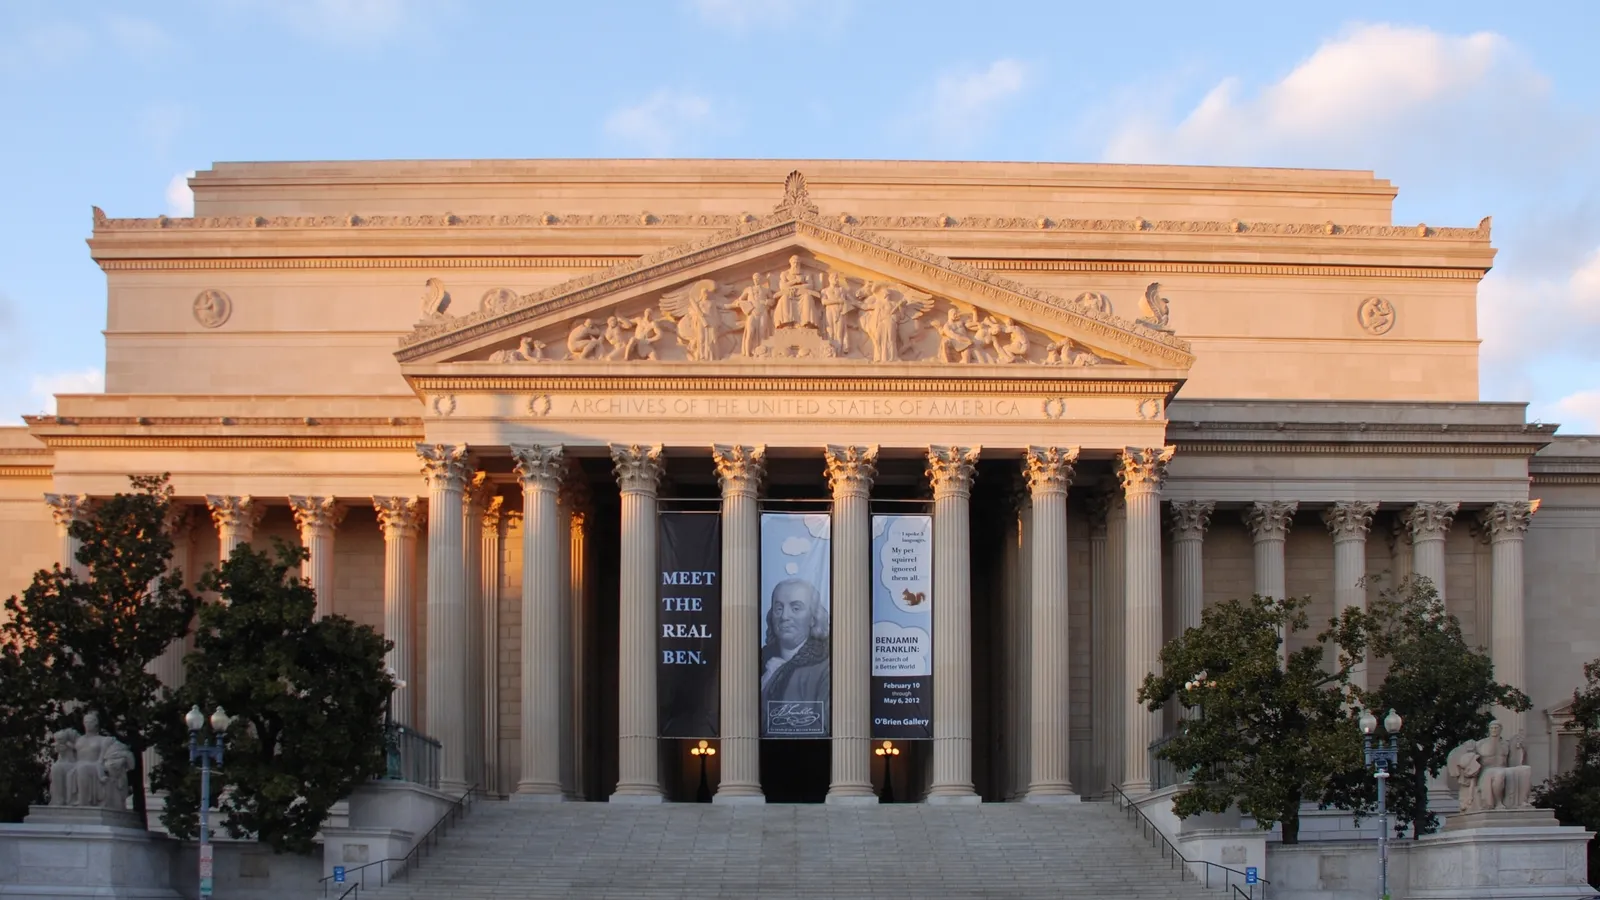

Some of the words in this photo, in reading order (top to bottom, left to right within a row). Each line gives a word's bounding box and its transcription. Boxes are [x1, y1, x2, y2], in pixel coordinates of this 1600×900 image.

[570, 398, 667, 415] ARCHIVES
[673, 398, 697, 415] OF
[705, 398, 739, 415] THE
[747, 398, 820, 416] UNITED
[827, 399, 893, 416] STATES
[899, 399, 923, 416] OF
[928, 399, 1021, 416] AMERICA
[892, 547, 902, 555] My
[903, 547, 914, 555] pet
[891, 556, 917, 564] squirrel
[662, 571, 716, 585] MEET
[662, 597, 703, 612] THE
[662, 624, 712, 638] REAL
[875, 636, 919, 644] BENJAMIN
[662, 650, 707, 665] BEN.
[903, 718, 929, 726] Gallery
